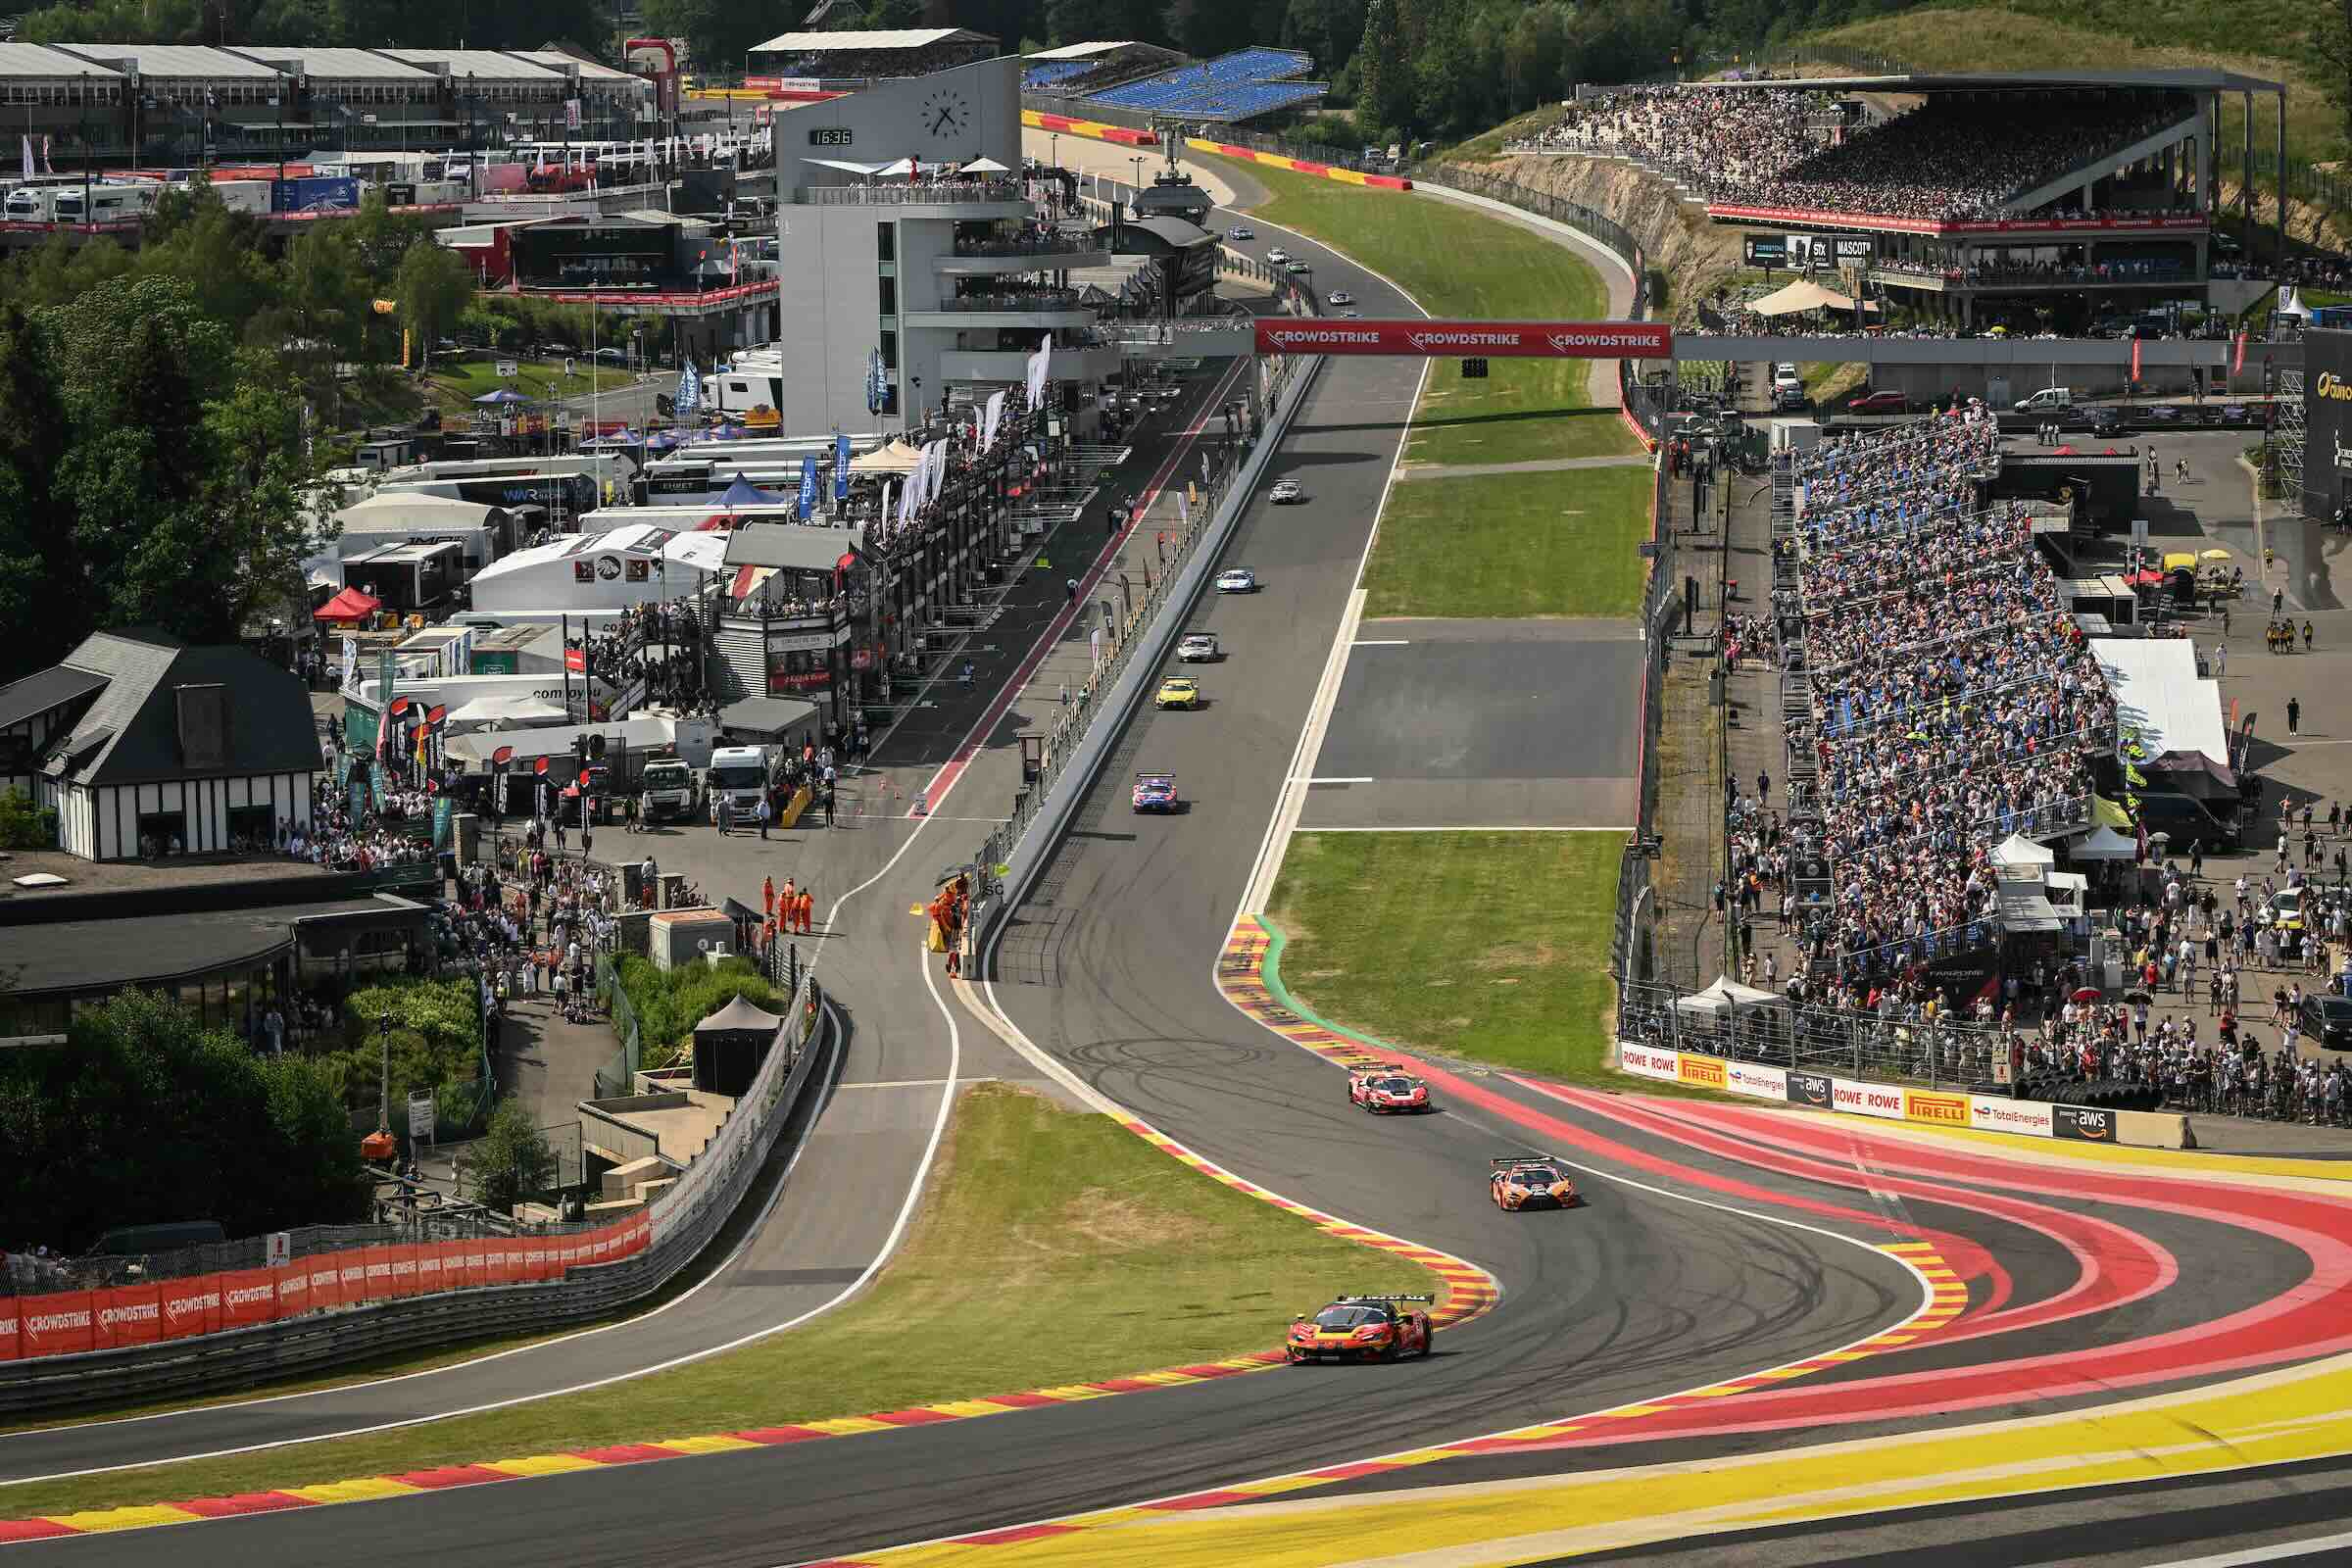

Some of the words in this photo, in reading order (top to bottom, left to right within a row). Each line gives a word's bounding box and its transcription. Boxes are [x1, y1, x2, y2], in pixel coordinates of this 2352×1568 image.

[816, 130, 851, 145] 16:36
[1275, 331, 1380, 344] CROWDSTRIKE
[1416, 332, 1520, 346] CROWDSTRIKE
[1556, 334, 1661, 347] CROWDSTRIKE
[533, 688, 602, 700] comoyu
[985, 884, 1004, 896] SC
[1623, 1051, 1647, 1067] ROWE
[1651, 1056, 1675, 1073] ROWE
[1681, 1058, 1723, 1084] PIRELLI
[1742, 1073, 1786, 1092] TotalEnergies
[1805, 1078, 1827, 1094] aws
[1834, 1088, 1862, 1105] ROWE
[1867, 1093, 1900, 1110] ROWE
[1908, 1095, 1965, 1120] PIRELLI
[1992, 1108, 2050, 1127] TotalEnergies
[2079, 1109, 2107, 1127] aws
[171, 1292, 220, 1313] CROWDSTRIKE
[229, 1285, 274, 1303] CROWDSTRIKE
[30, 1310, 91, 1333] CROWDSTRIKE
[101, 1302, 160, 1324] CROWDSTRIKE
